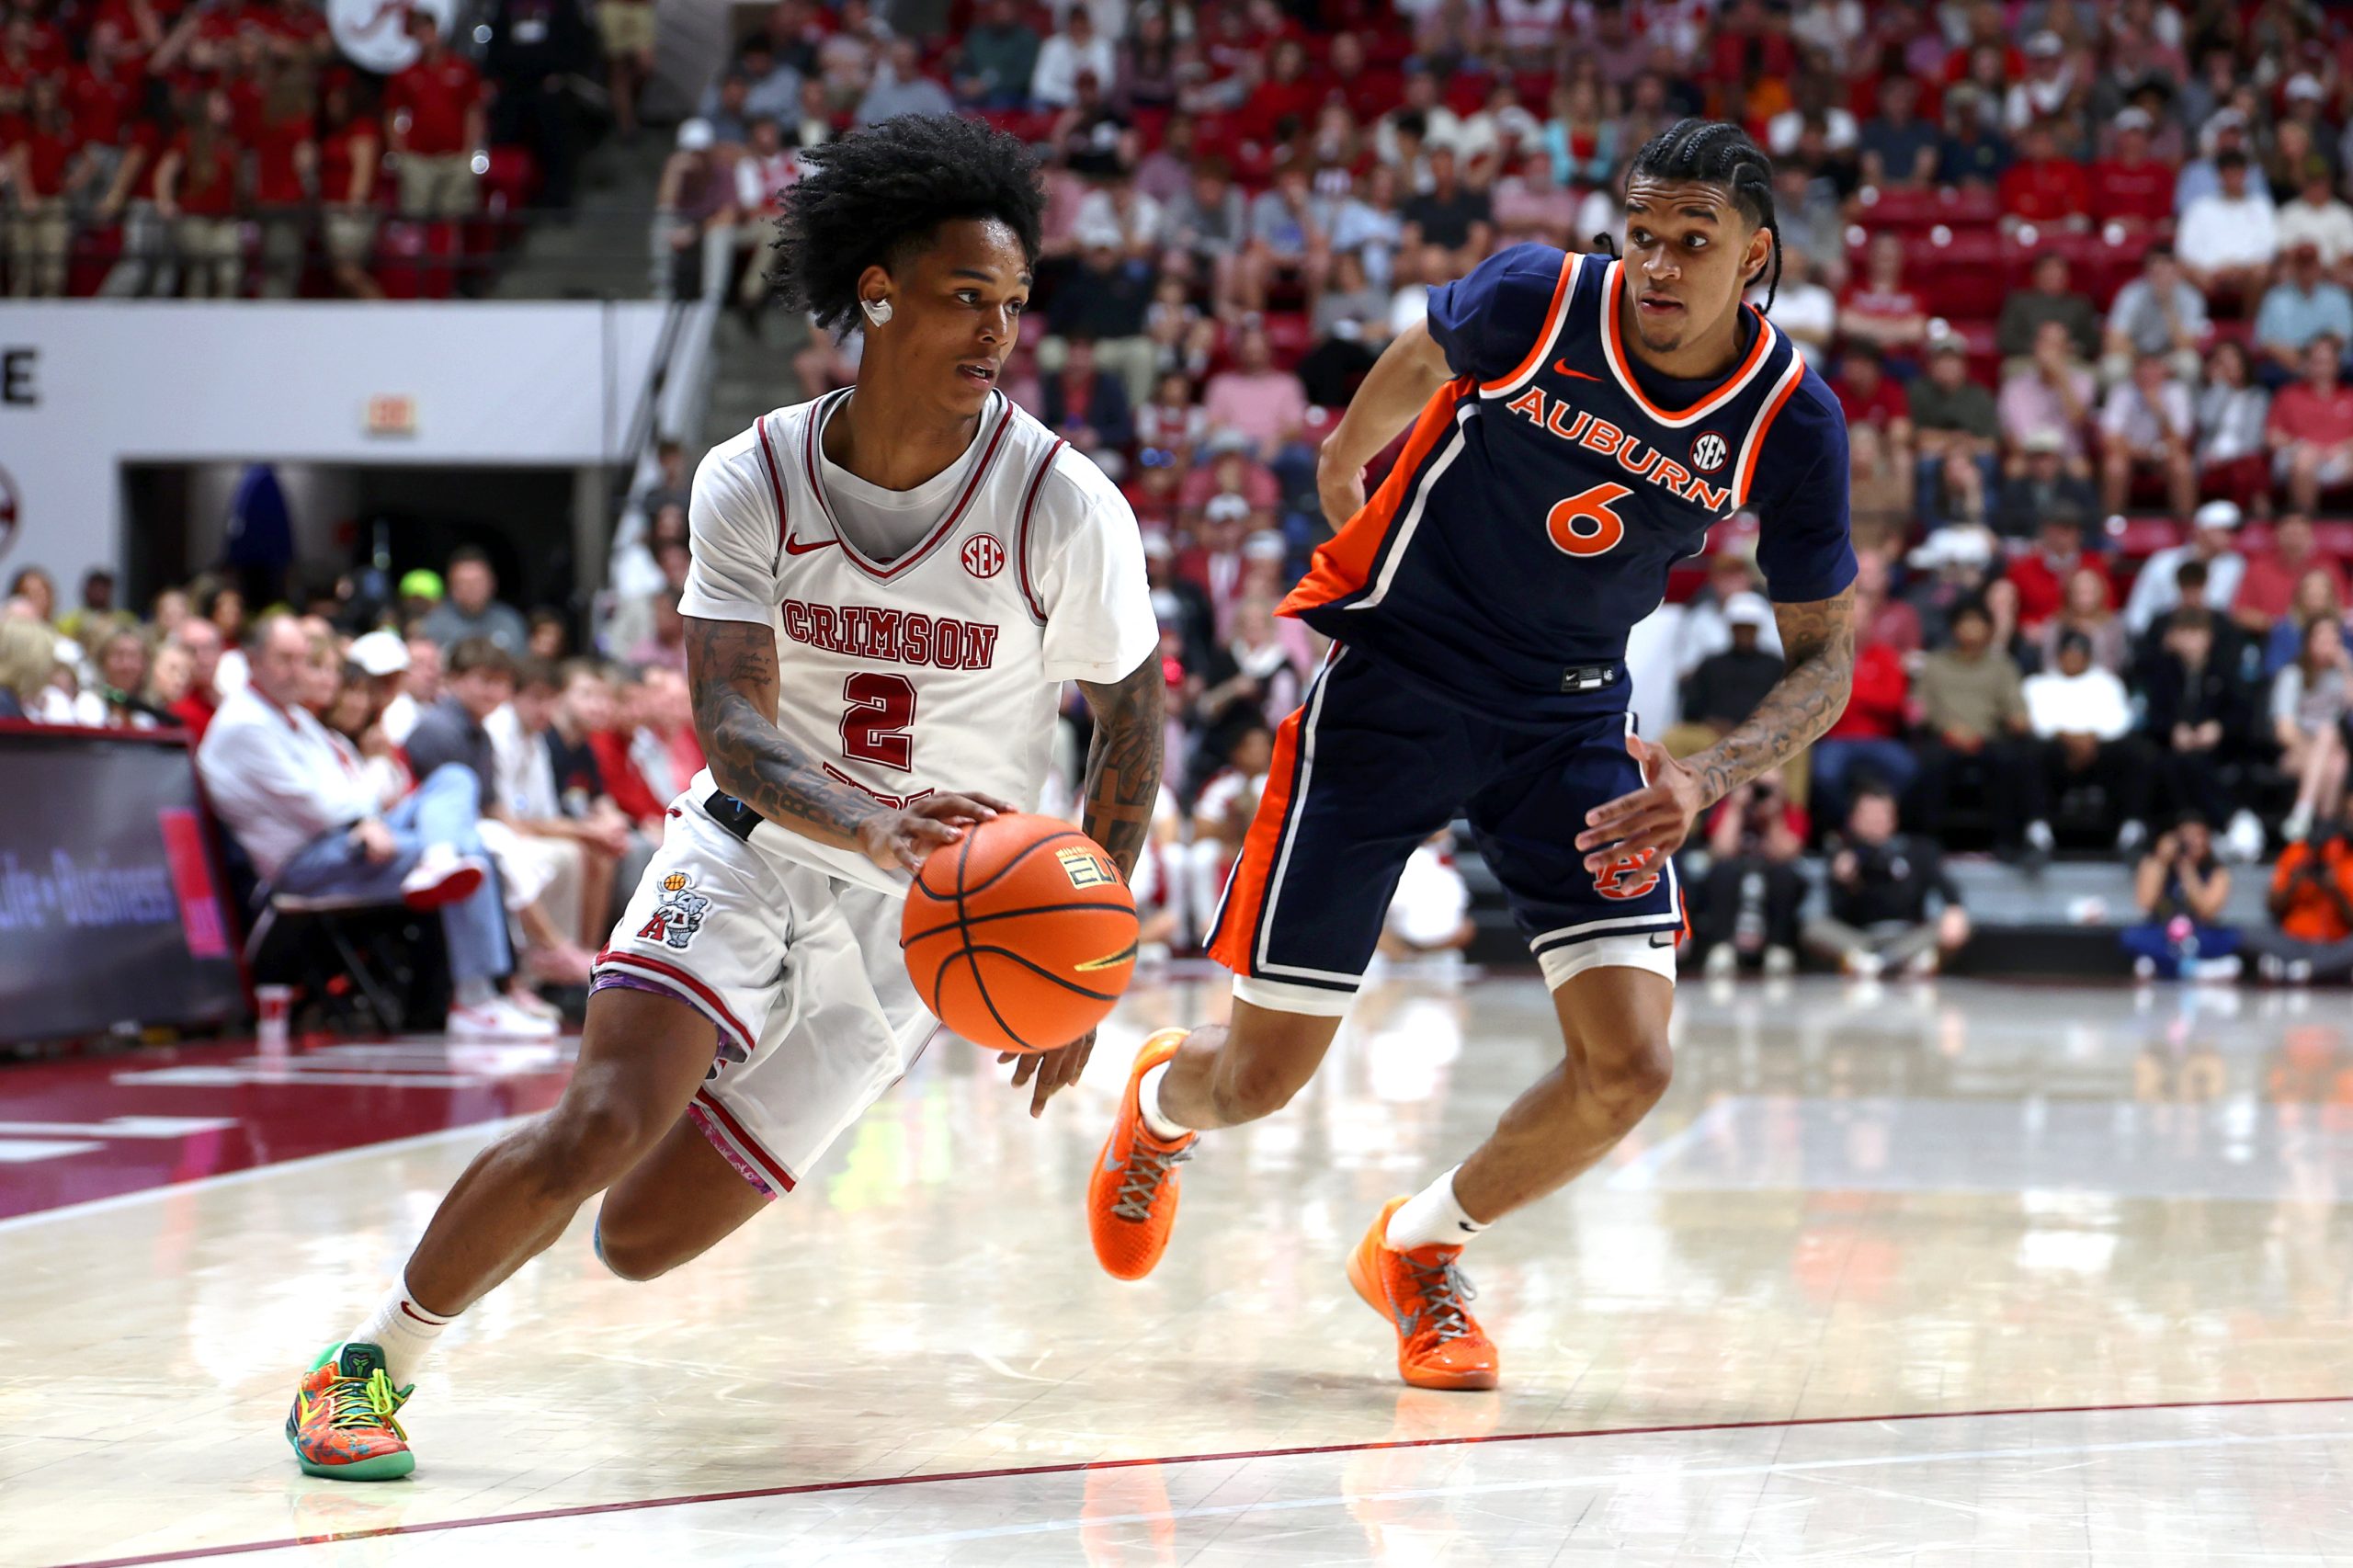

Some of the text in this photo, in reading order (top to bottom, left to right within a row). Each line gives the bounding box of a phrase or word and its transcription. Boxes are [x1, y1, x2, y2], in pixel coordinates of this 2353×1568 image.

[1506, 385, 1732, 513] AUBURN
[1693, 434, 1727, 471] SEC
[1546, 482, 1635, 558] 6
[963, 537, 1003, 577] SEC
[781, 599, 999, 671] CRIMSON
[838, 672, 917, 774] 2
[636, 912, 667, 942] A
